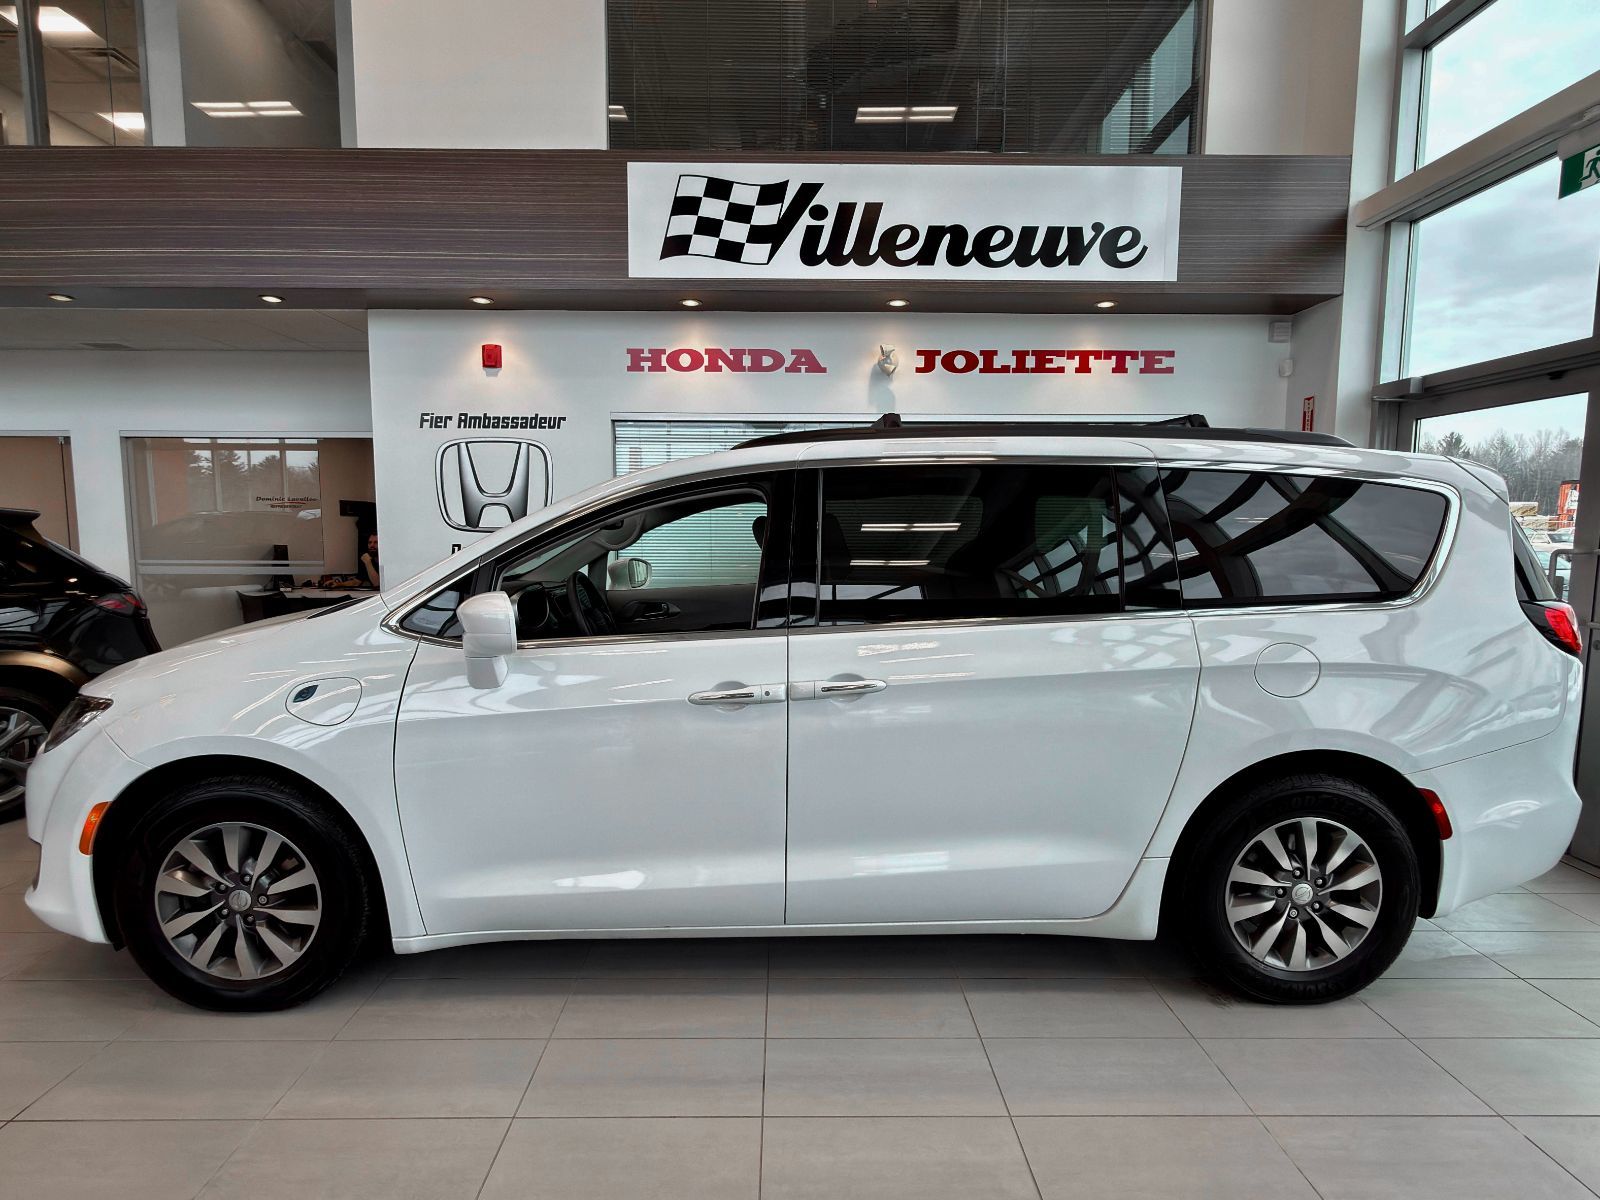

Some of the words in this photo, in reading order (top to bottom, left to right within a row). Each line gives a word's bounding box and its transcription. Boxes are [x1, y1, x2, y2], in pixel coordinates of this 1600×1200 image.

[755, 182, 1148, 269] Villeneuve
[627, 348, 828, 373] HONDA
[915, 349, 1175, 374] JOLIETTE
[419, 413, 452, 429] Fier
[457, 413, 567, 430] Ambassadeur
